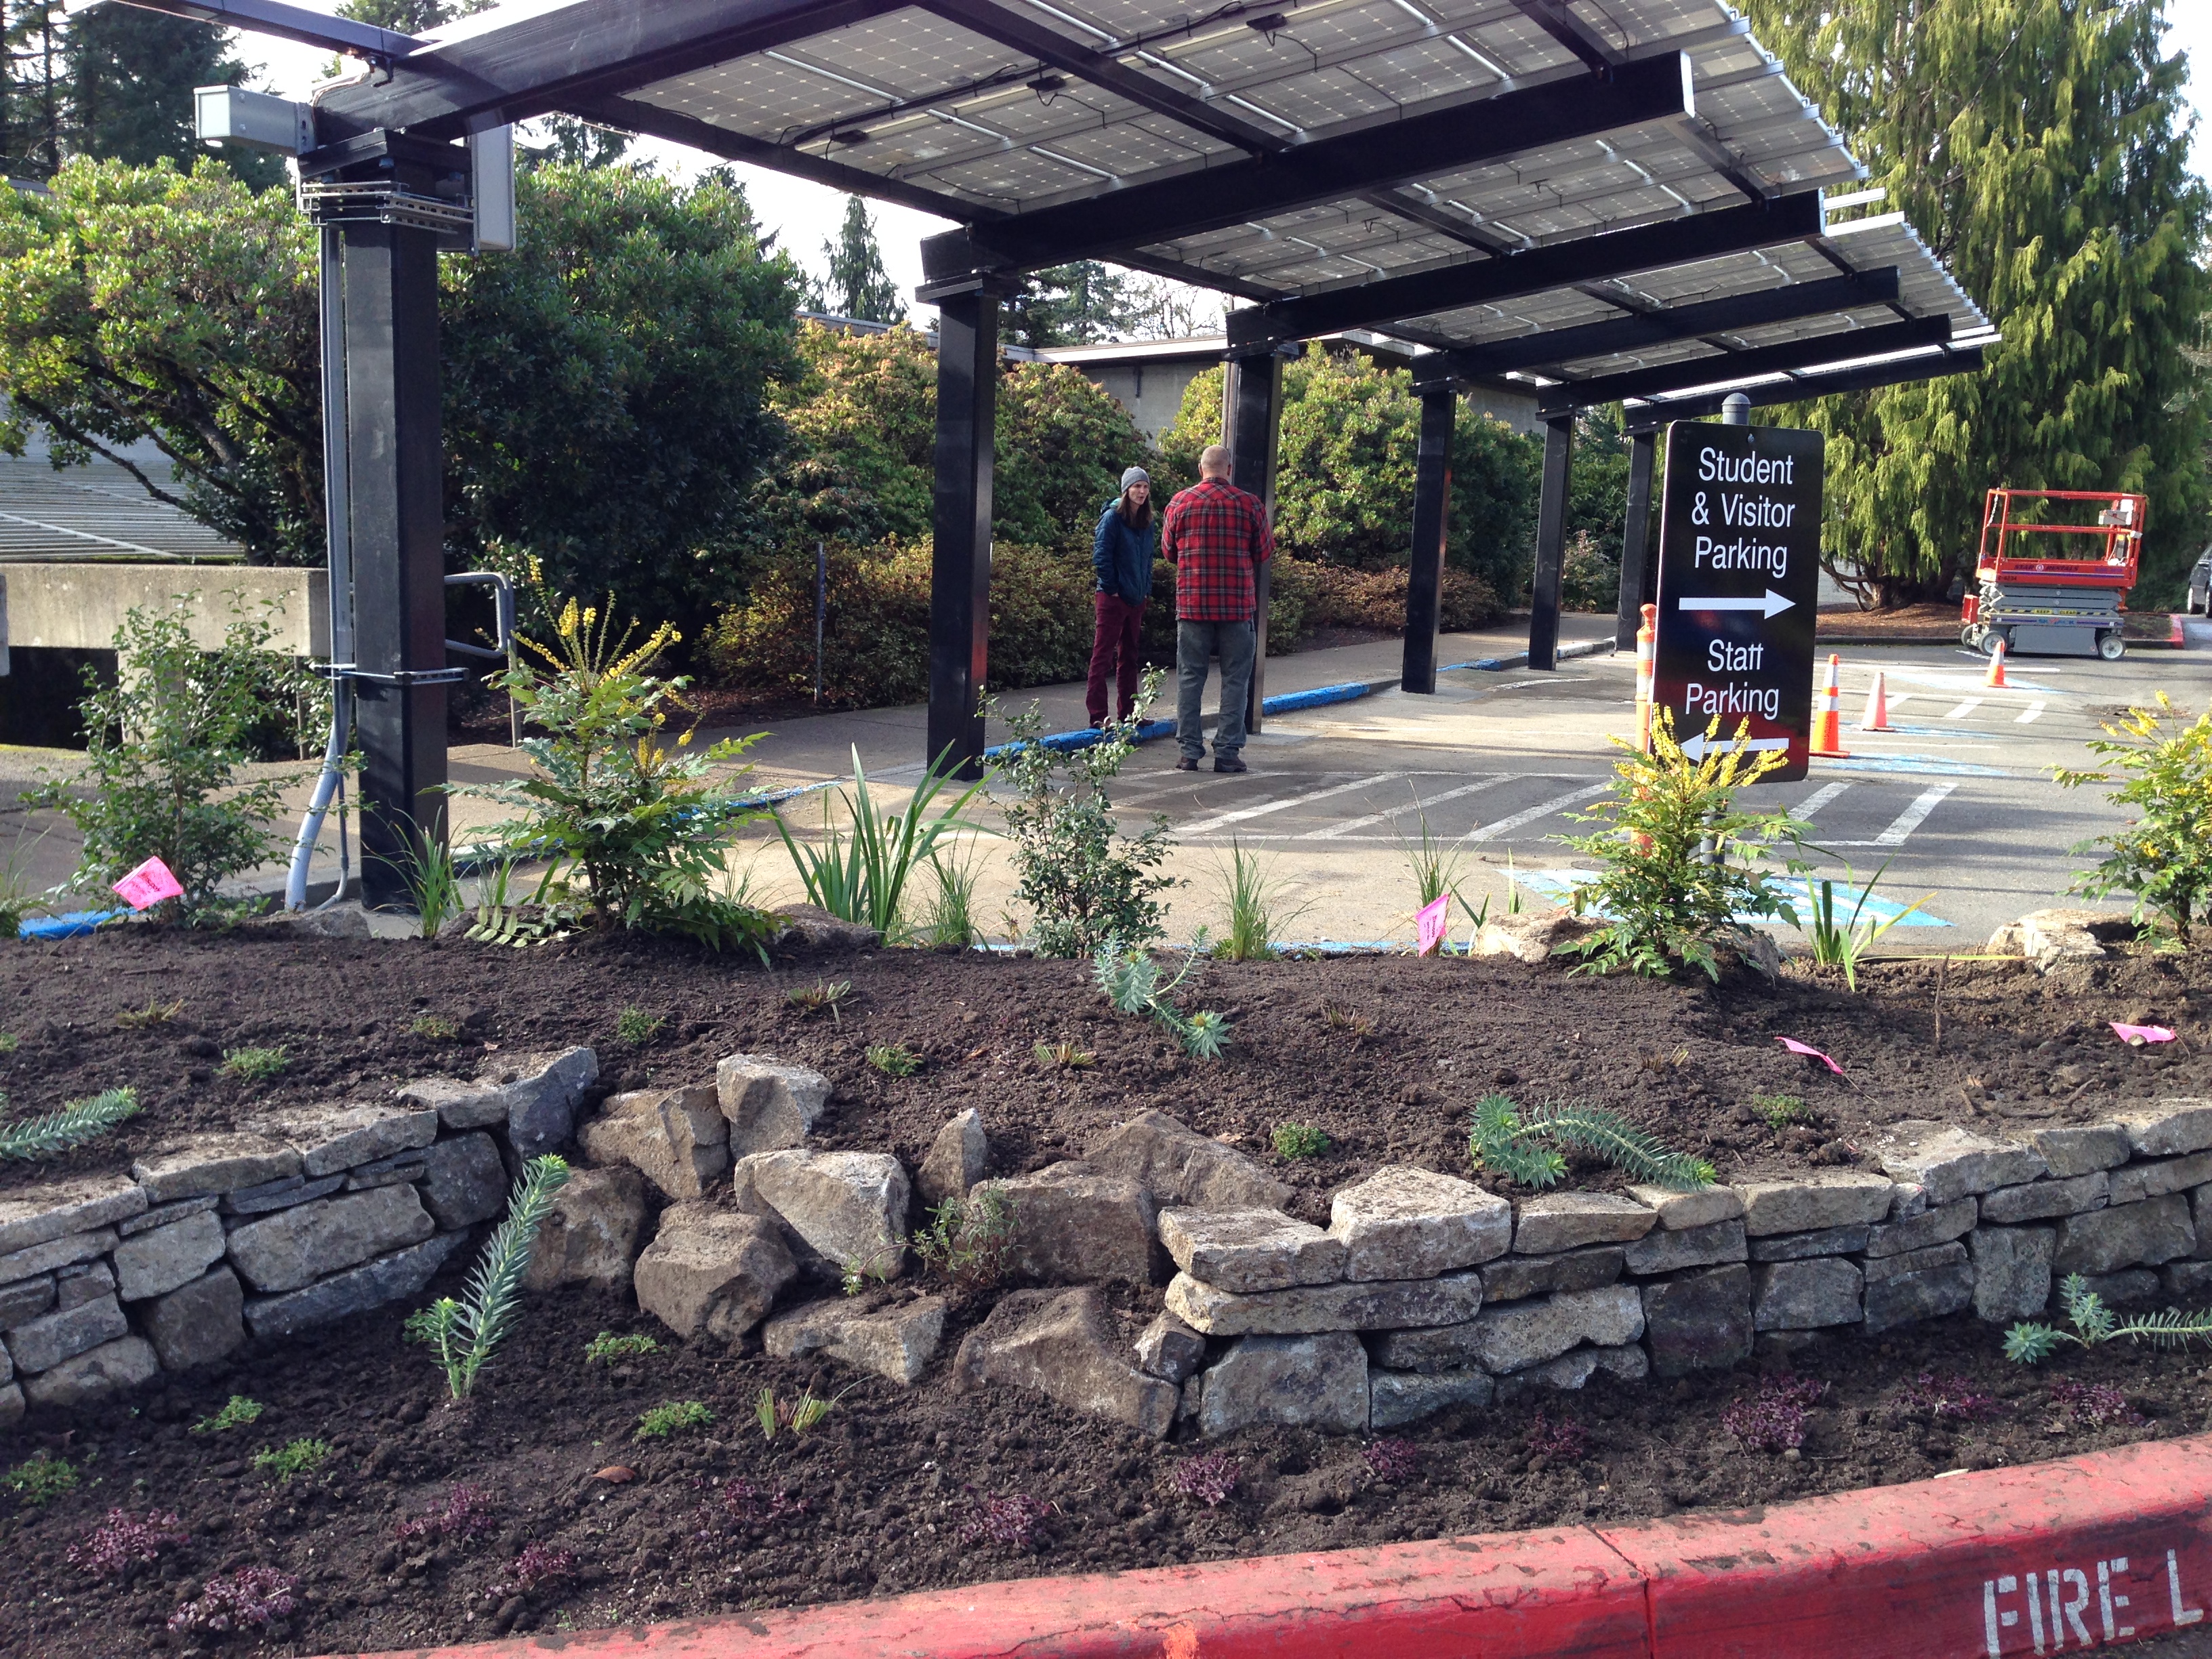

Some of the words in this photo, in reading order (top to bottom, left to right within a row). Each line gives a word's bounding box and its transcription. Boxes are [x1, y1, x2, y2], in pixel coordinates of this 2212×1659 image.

[1699, 447, 1793, 485] Student
[1692, 491, 1710, 525] &
[1721, 492, 1795, 528] Visitor
[1695, 536, 1788, 578] Parking
[1707, 639, 1763, 672] Staff
[1685, 682, 1780, 720] Parking
[1984, 1557, 2135, 1659] FIRE
